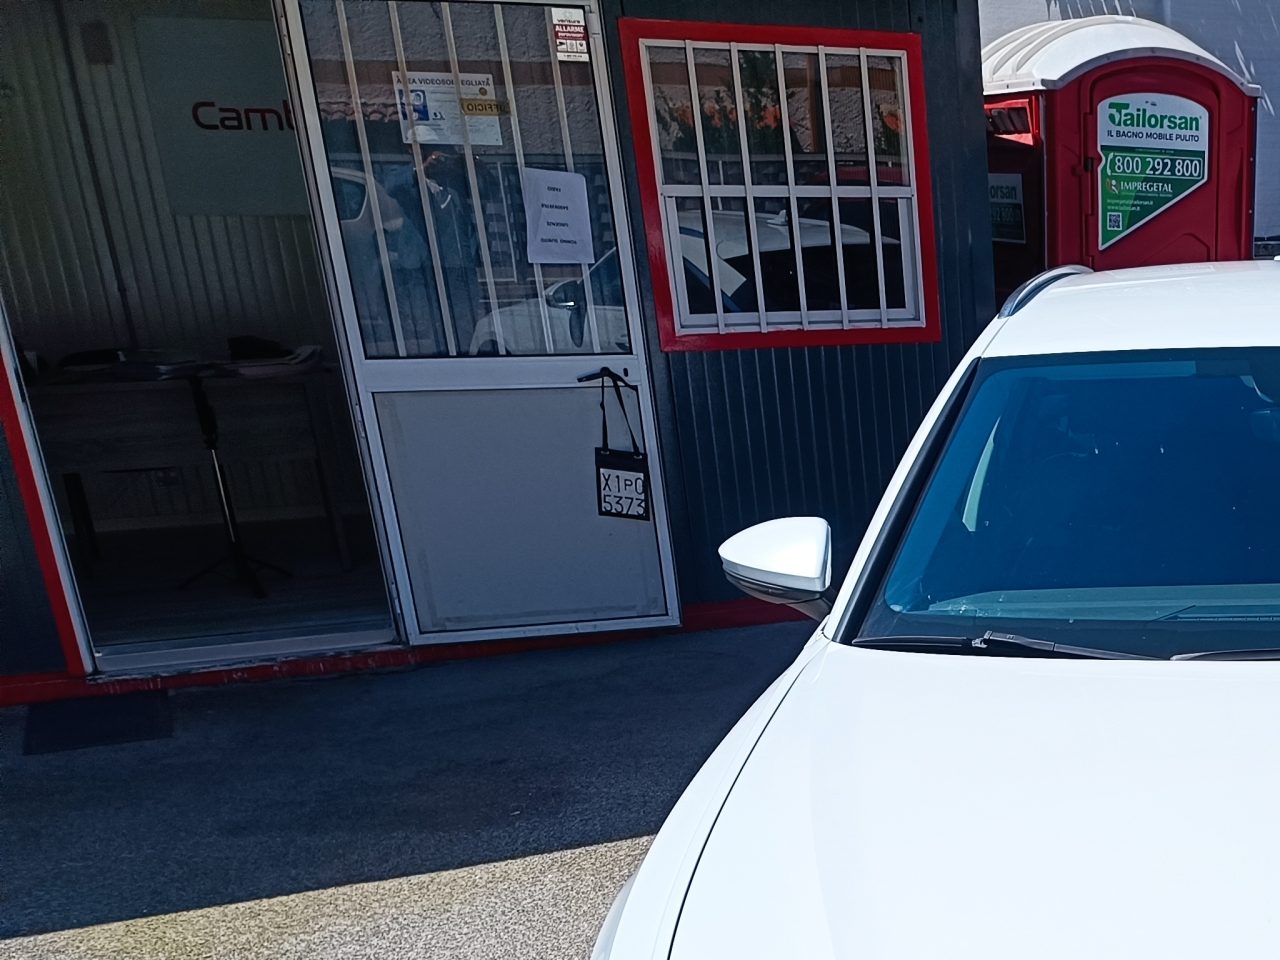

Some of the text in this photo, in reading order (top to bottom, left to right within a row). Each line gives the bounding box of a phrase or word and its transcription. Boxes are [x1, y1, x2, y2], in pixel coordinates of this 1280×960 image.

[419, 78, 491, 87] VIDEOSOEGLIATA
[1108, 102, 1200, 131] Tailorsan
[1107, 130, 1200, 143] IL BAGNO MOBILE PULITO
[1115, 156, 1200, 177] 800 292 800
[1120, 181, 1173, 193] IMPREGETAL
[603, 494, 646, 516] 5373
